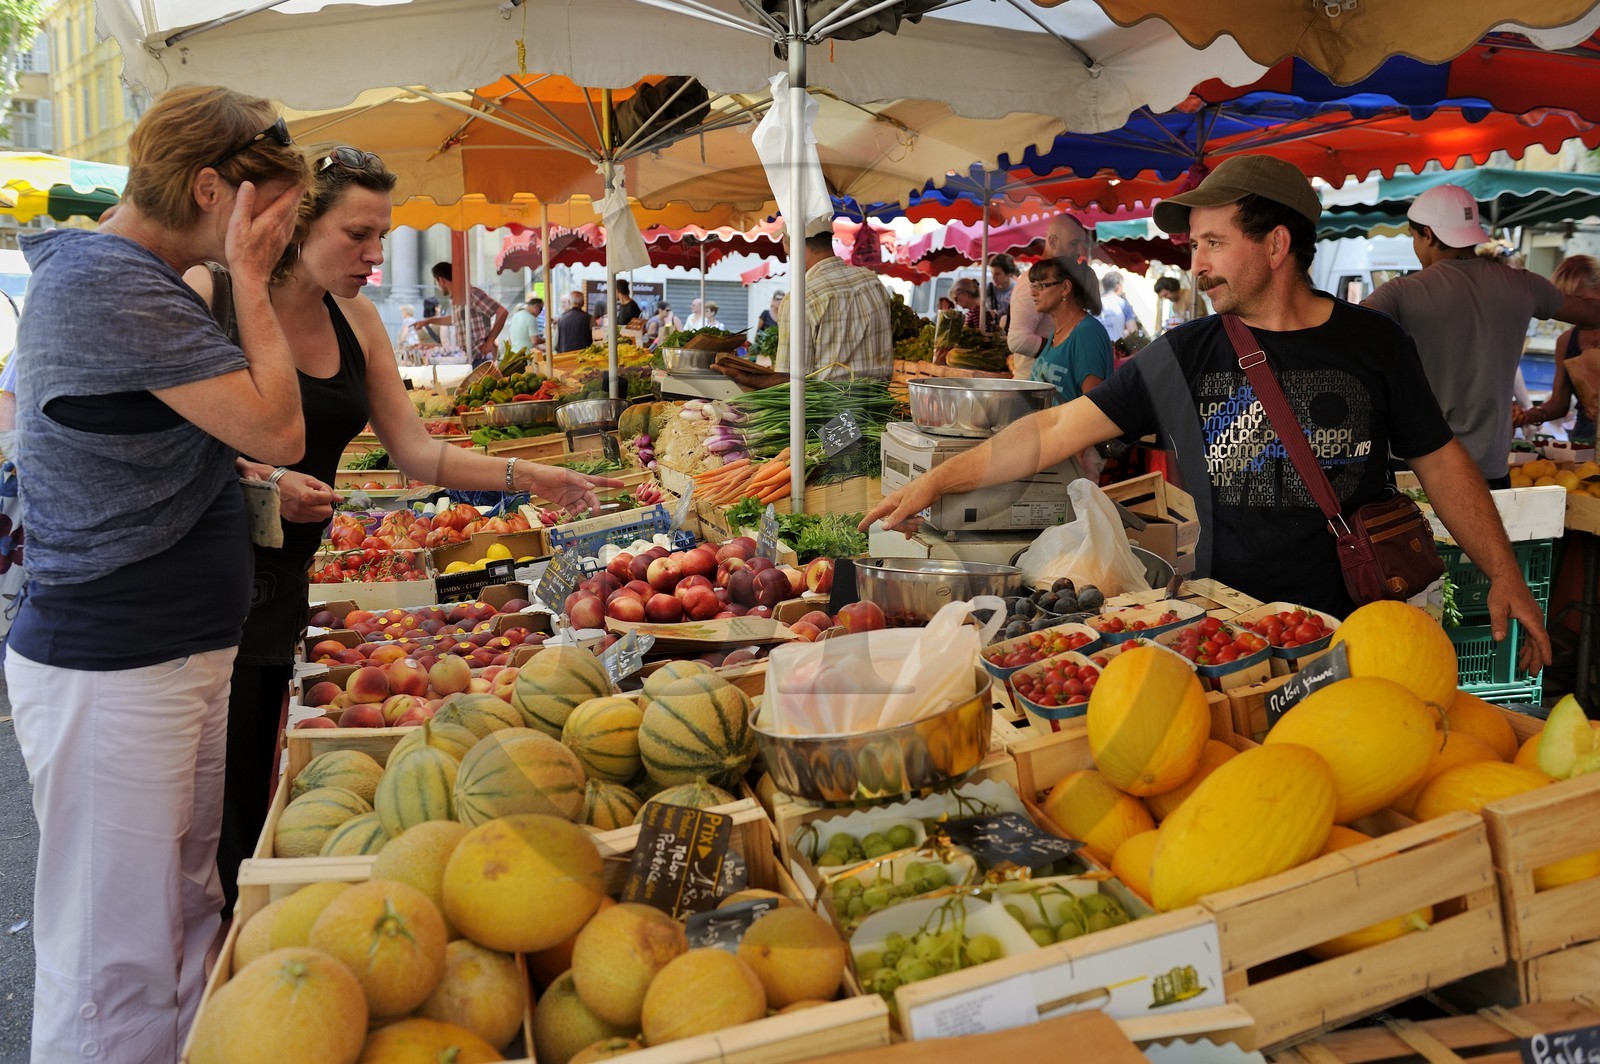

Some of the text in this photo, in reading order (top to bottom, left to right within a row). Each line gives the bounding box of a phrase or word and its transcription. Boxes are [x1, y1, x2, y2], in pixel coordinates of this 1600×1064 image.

[440, 585, 461, 594] LIMON
[465, 580, 489, 590] CITRON
[700, 813, 723, 845] Prix
